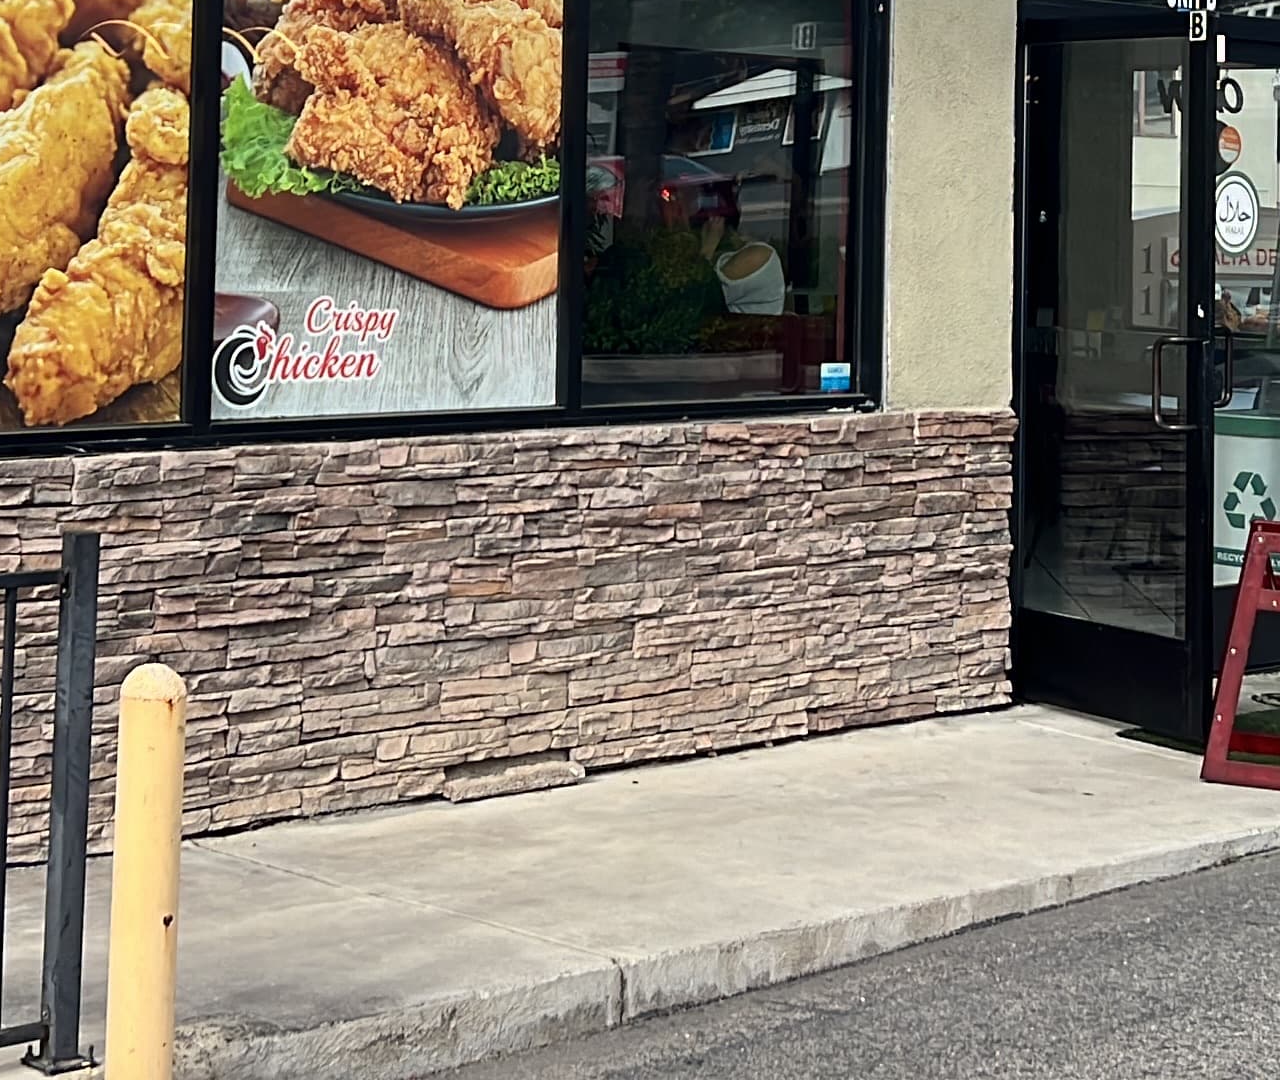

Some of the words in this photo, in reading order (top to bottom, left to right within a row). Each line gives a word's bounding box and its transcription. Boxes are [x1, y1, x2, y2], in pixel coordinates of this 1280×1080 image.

[1191, 13, 1204, 39] B
[1219, 195, 1252, 223] حلال
[307, 298, 396, 342] Crispy
